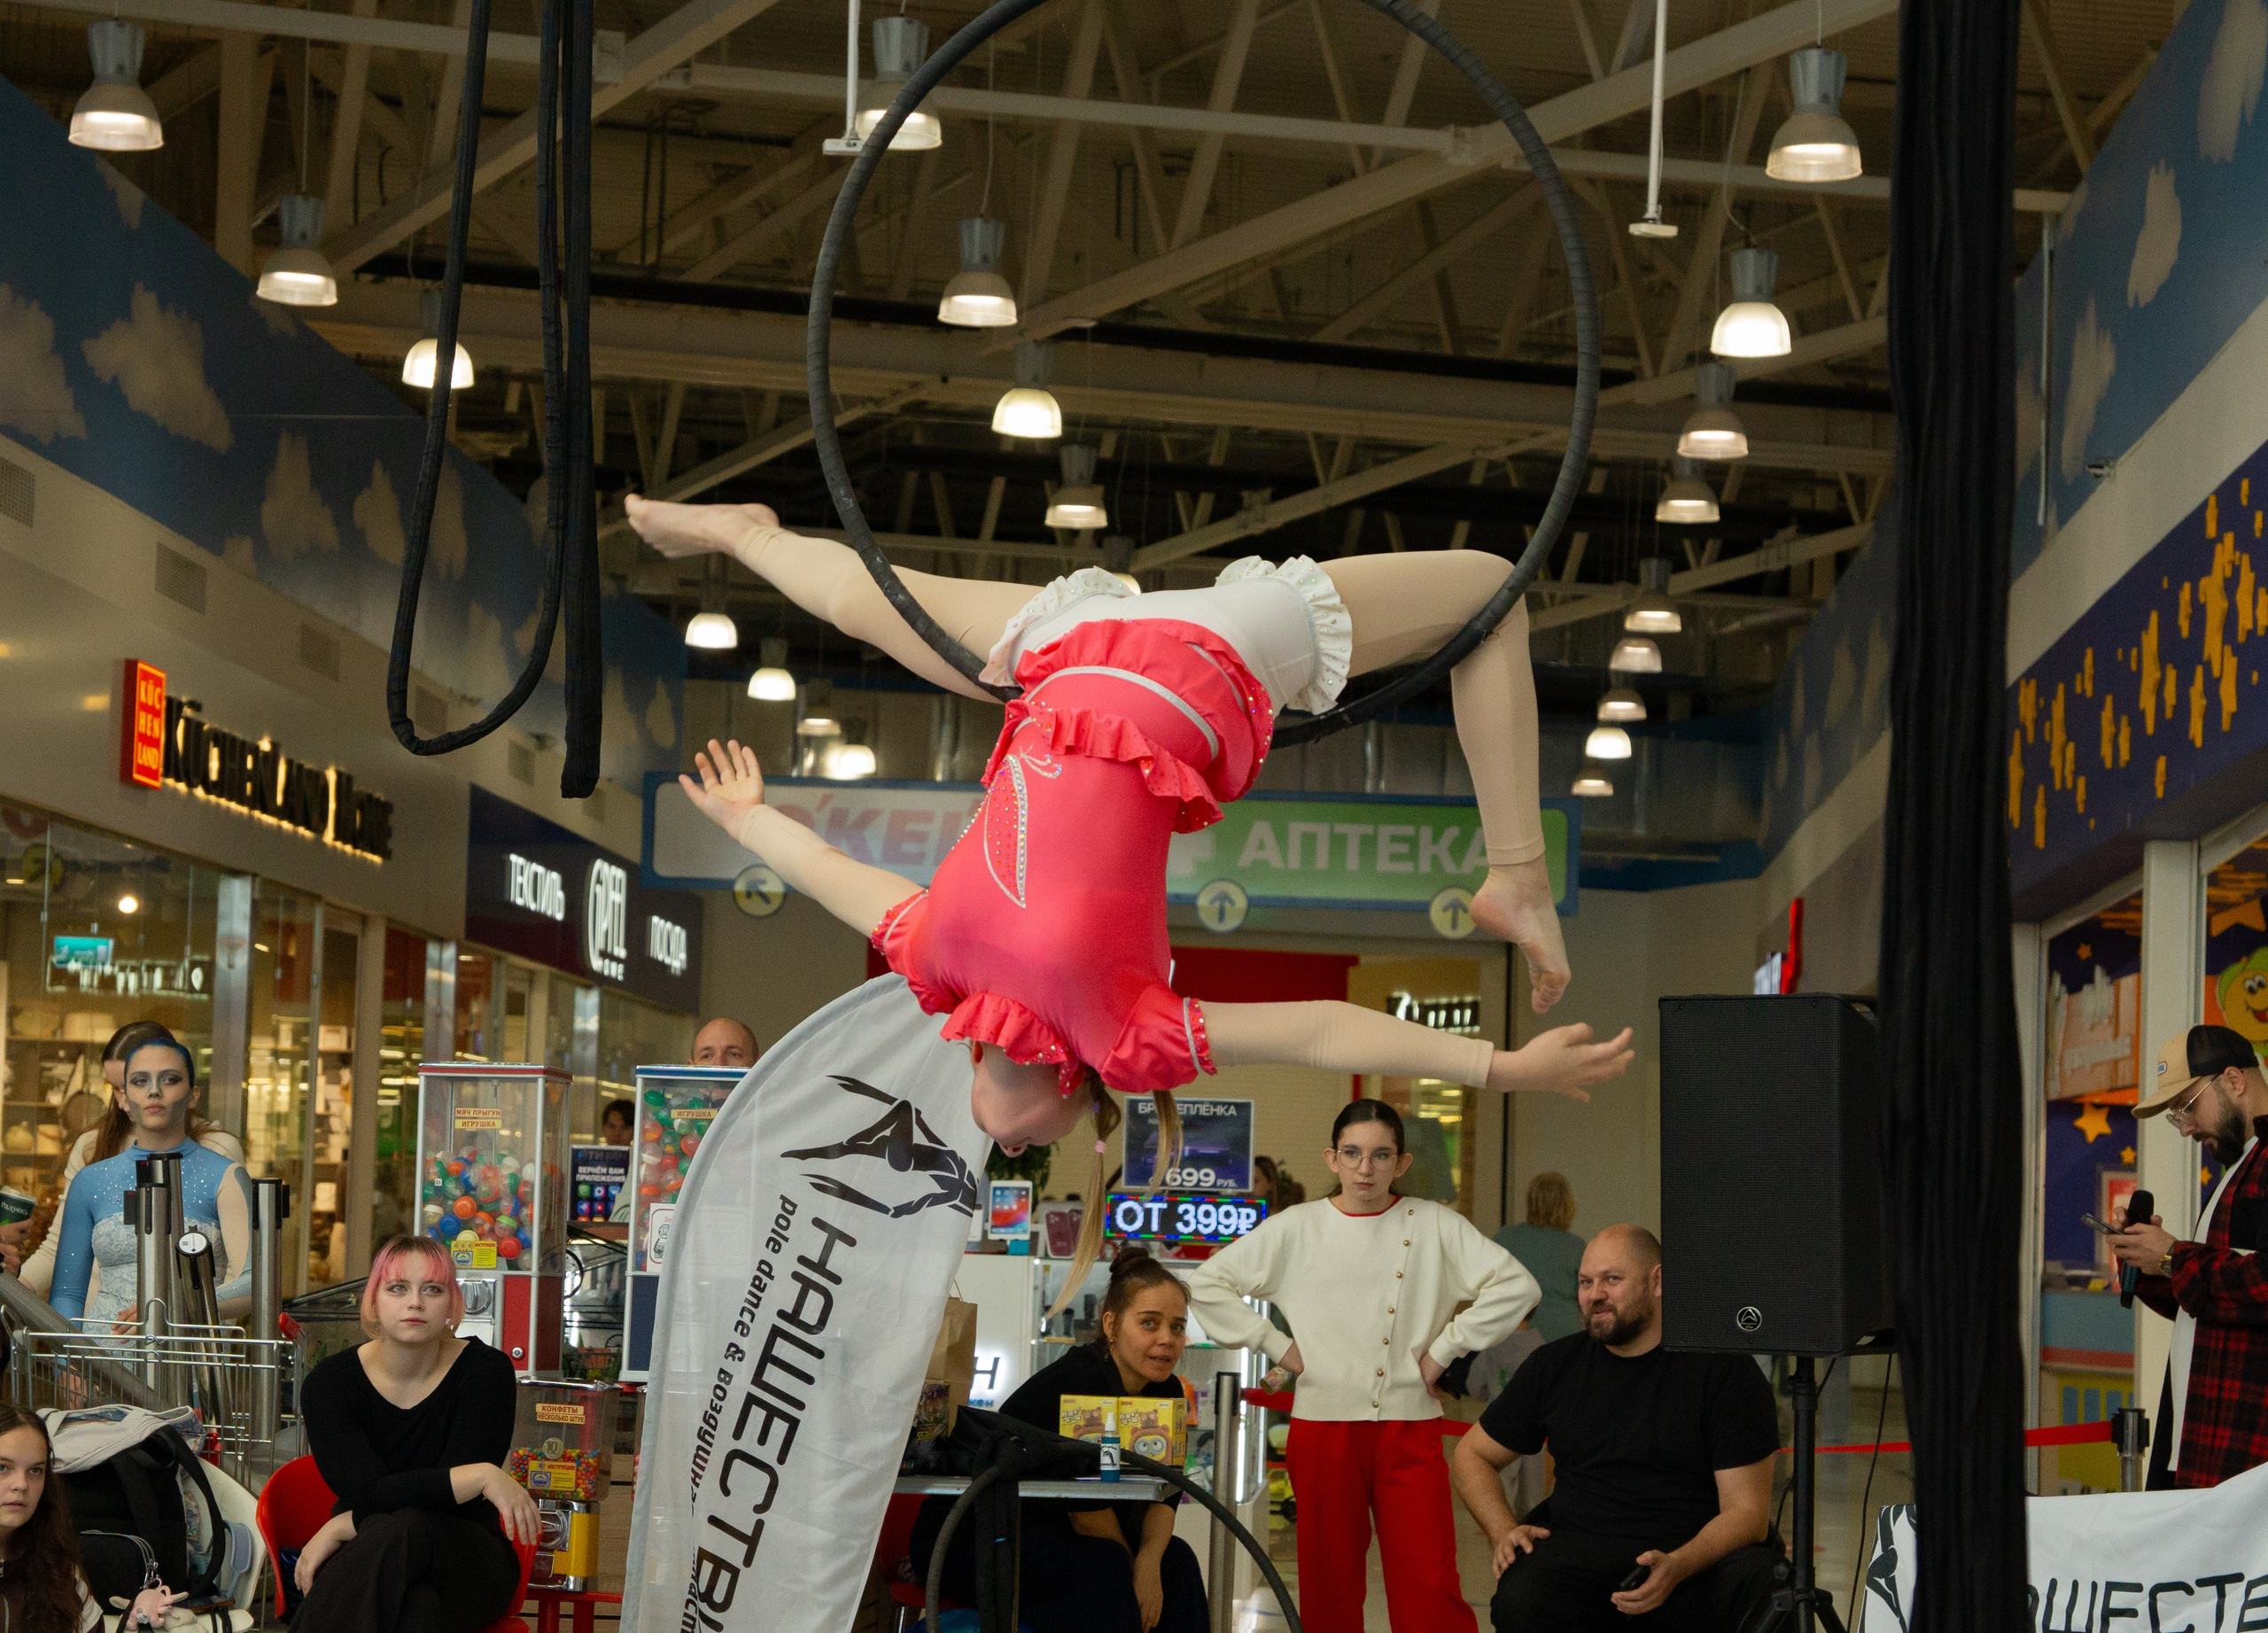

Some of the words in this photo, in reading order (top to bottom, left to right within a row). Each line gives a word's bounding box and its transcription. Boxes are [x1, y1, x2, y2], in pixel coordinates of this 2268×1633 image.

[138, 711, 160, 739] HEN
[137, 742, 159, 770] LAND
[509, 853, 564, 921] ТЕКСТИЛЬ
[1138, 1102, 1237, 1116] БРЕПЛЁНКА
[1166, 1168, 1216, 1186] 699
[1216, 1178, 1238, 1187] РУБ.
[765, 1194, 798, 1255] pole
[1115, 1201, 1168, 1232] ОТ
[734, 1259, 775, 1338] dance
[724, 1341, 747, 1363] &
[537, 1413, 569, 1422] НЕСКОЛЬКО
[541, 1405, 579, 1414] КОНФЕТЫ
